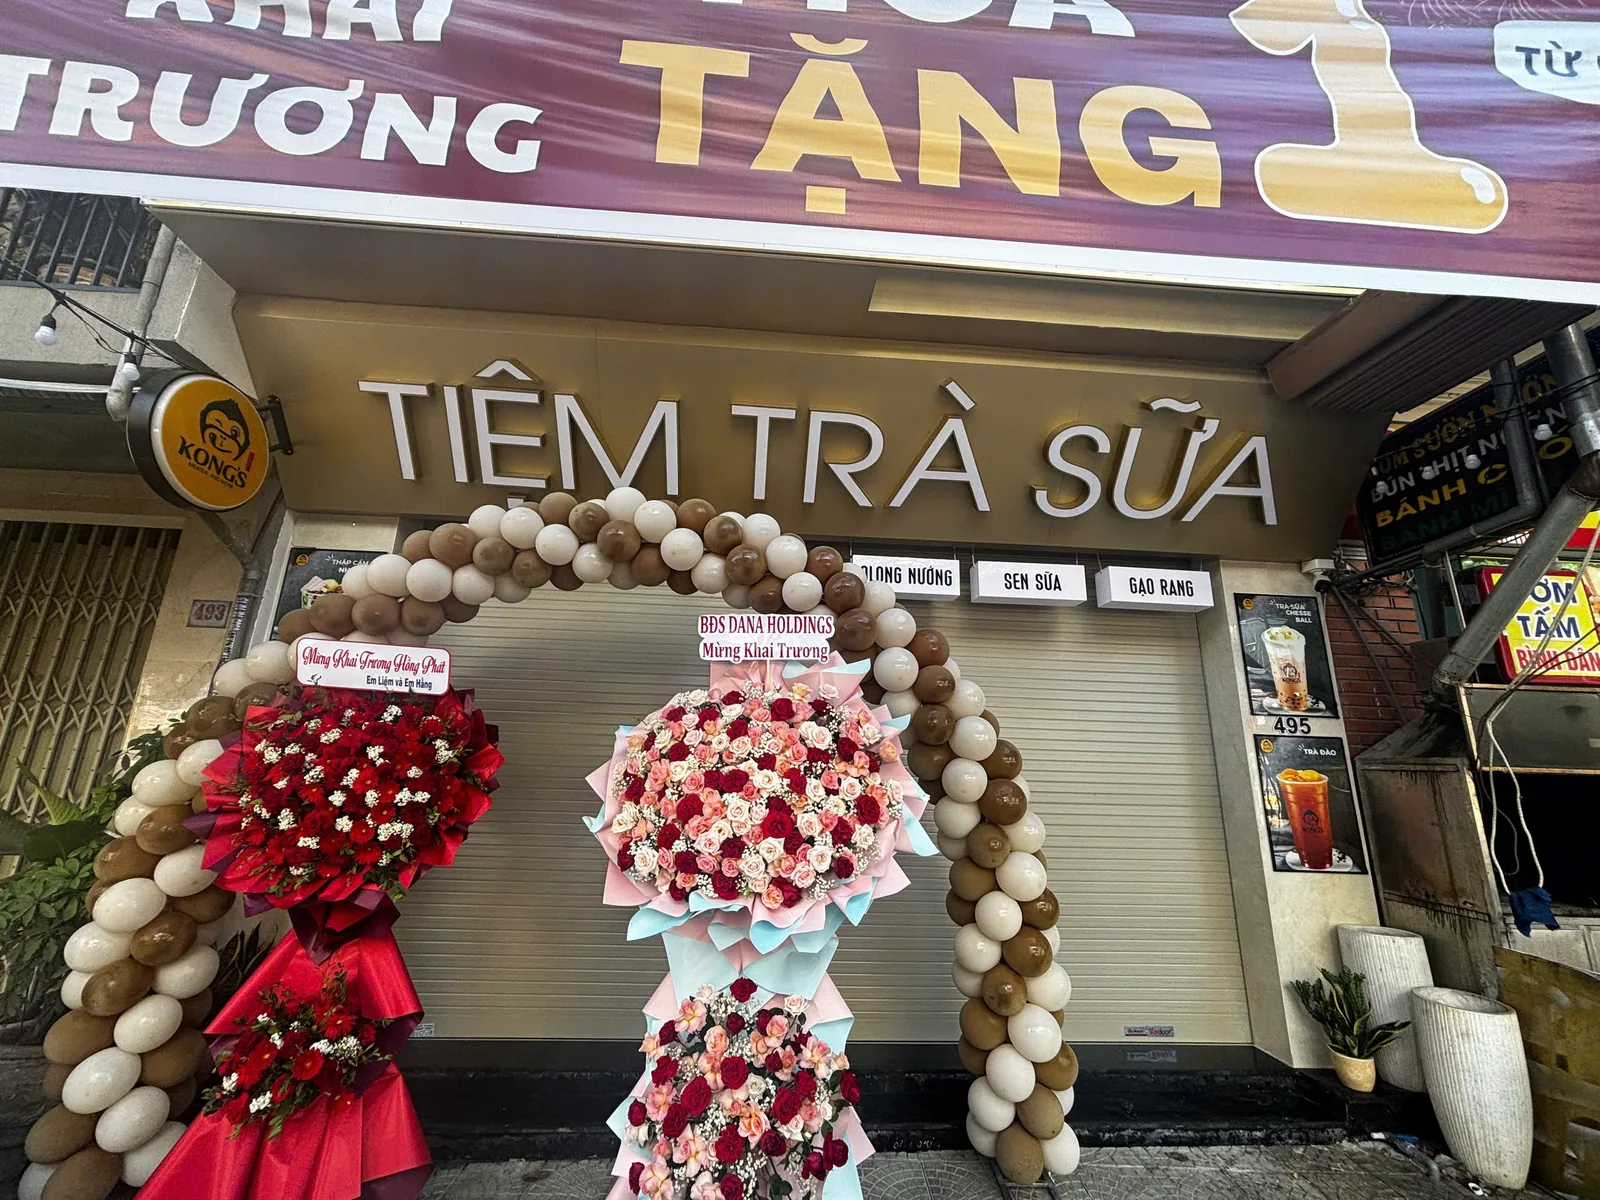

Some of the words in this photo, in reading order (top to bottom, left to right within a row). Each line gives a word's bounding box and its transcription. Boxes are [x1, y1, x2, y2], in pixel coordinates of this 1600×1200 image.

[1515, 40, 1582, 77] TỪ
[619, 32, 1222, 214] TẶNG
[358, 359, 679, 509] TIỆM
[730, 379, 991, 512] TRÀ
[1034, 397, 1277, 526] SỮA
[1376, 477, 1467, 528] BÁNH
[908, 565, 952, 586] NƯỚNG
[1004, 572, 1029, 590] SEN
[1035, 571, 1062, 591] SỮA
[1129, 577, 1155, 597] GẠO
[1160, 578, 1194, 597] RANG
[1530, 578, 1577, 603] ƠM
[193, 603, 227, 621] 493
[1517, 606, 1580, 638] TẤM
[700, 615, 726, 634] BĐS
[729, 616, 764, 634] DANA
[767, 616, 833, 634] HOLDINGS
[302, 646, 331, 669] Mừng
[332, 648, 358, 669] Khai
[702, 641, 741, 662] Mừng
[744, 642, 773, 658] Khai
[777, 643, 828, 662] Trương
[367, 675, 377, 685] Em
[395, 677, 403, 687] và
[404, 678, 414, 688] Em
[1273, 716, 1312, 735] 495
[1319, 748, 1337, 756] ĐÀO
